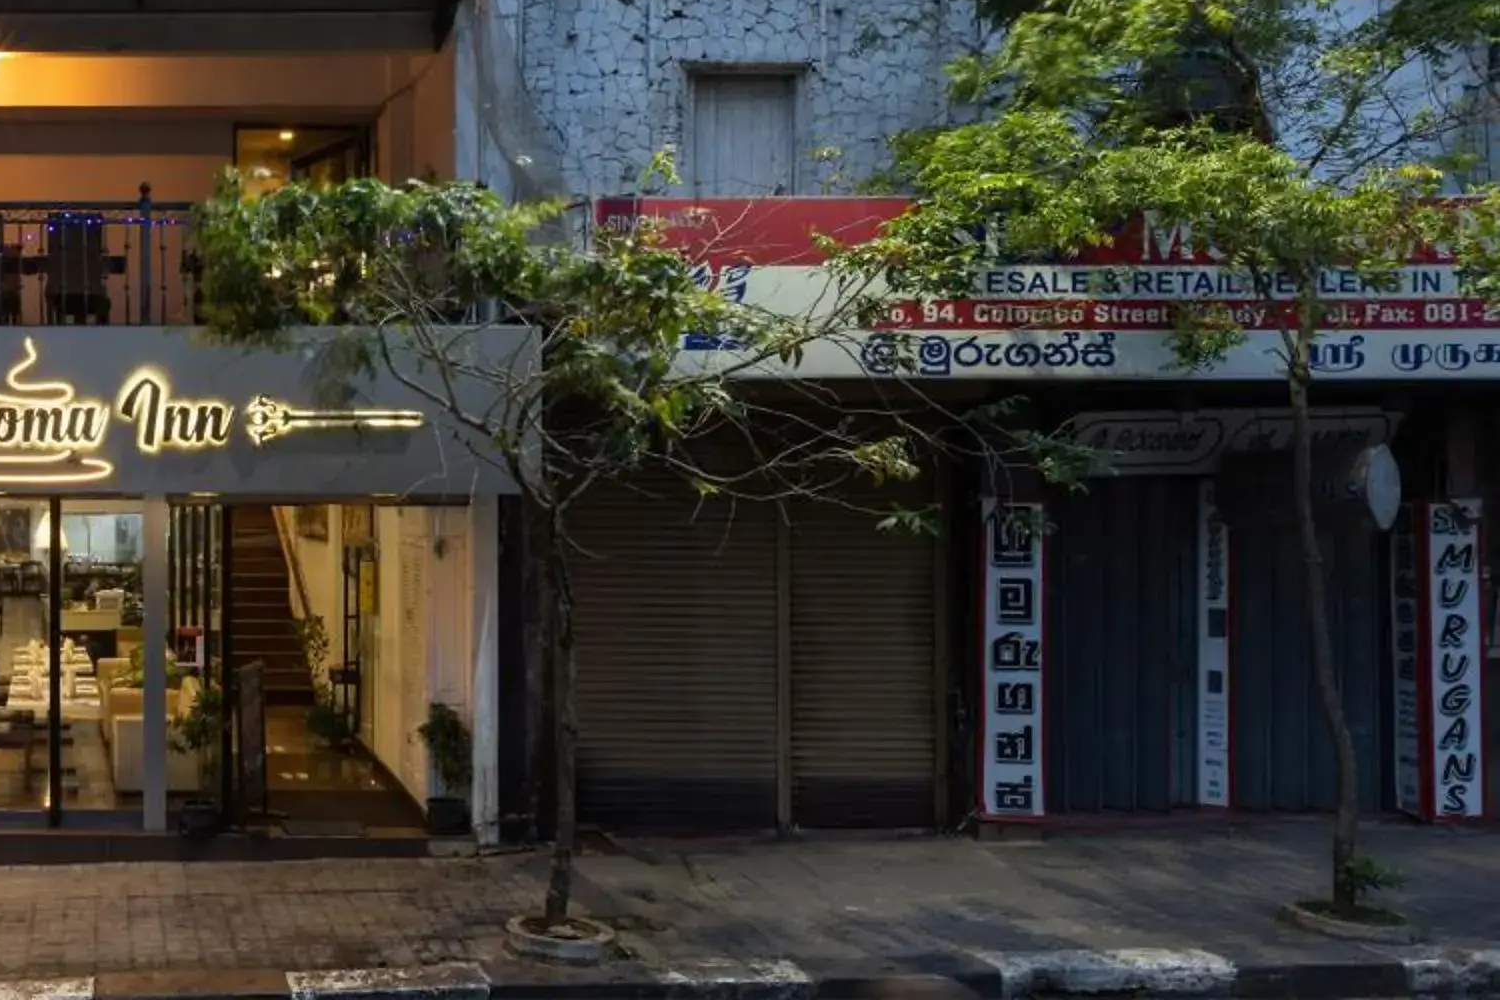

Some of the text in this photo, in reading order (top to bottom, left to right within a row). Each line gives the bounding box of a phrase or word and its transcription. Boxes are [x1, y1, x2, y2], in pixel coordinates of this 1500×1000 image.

[1132, 271, 1242, 294] RETAIL
[1412, 271, 1441, 293] IN
[1365, 303, 1416, 324] Fax:
[120, 375, 233, 448] Inn
[1434, 542, 1477, 815] MURUGANS
